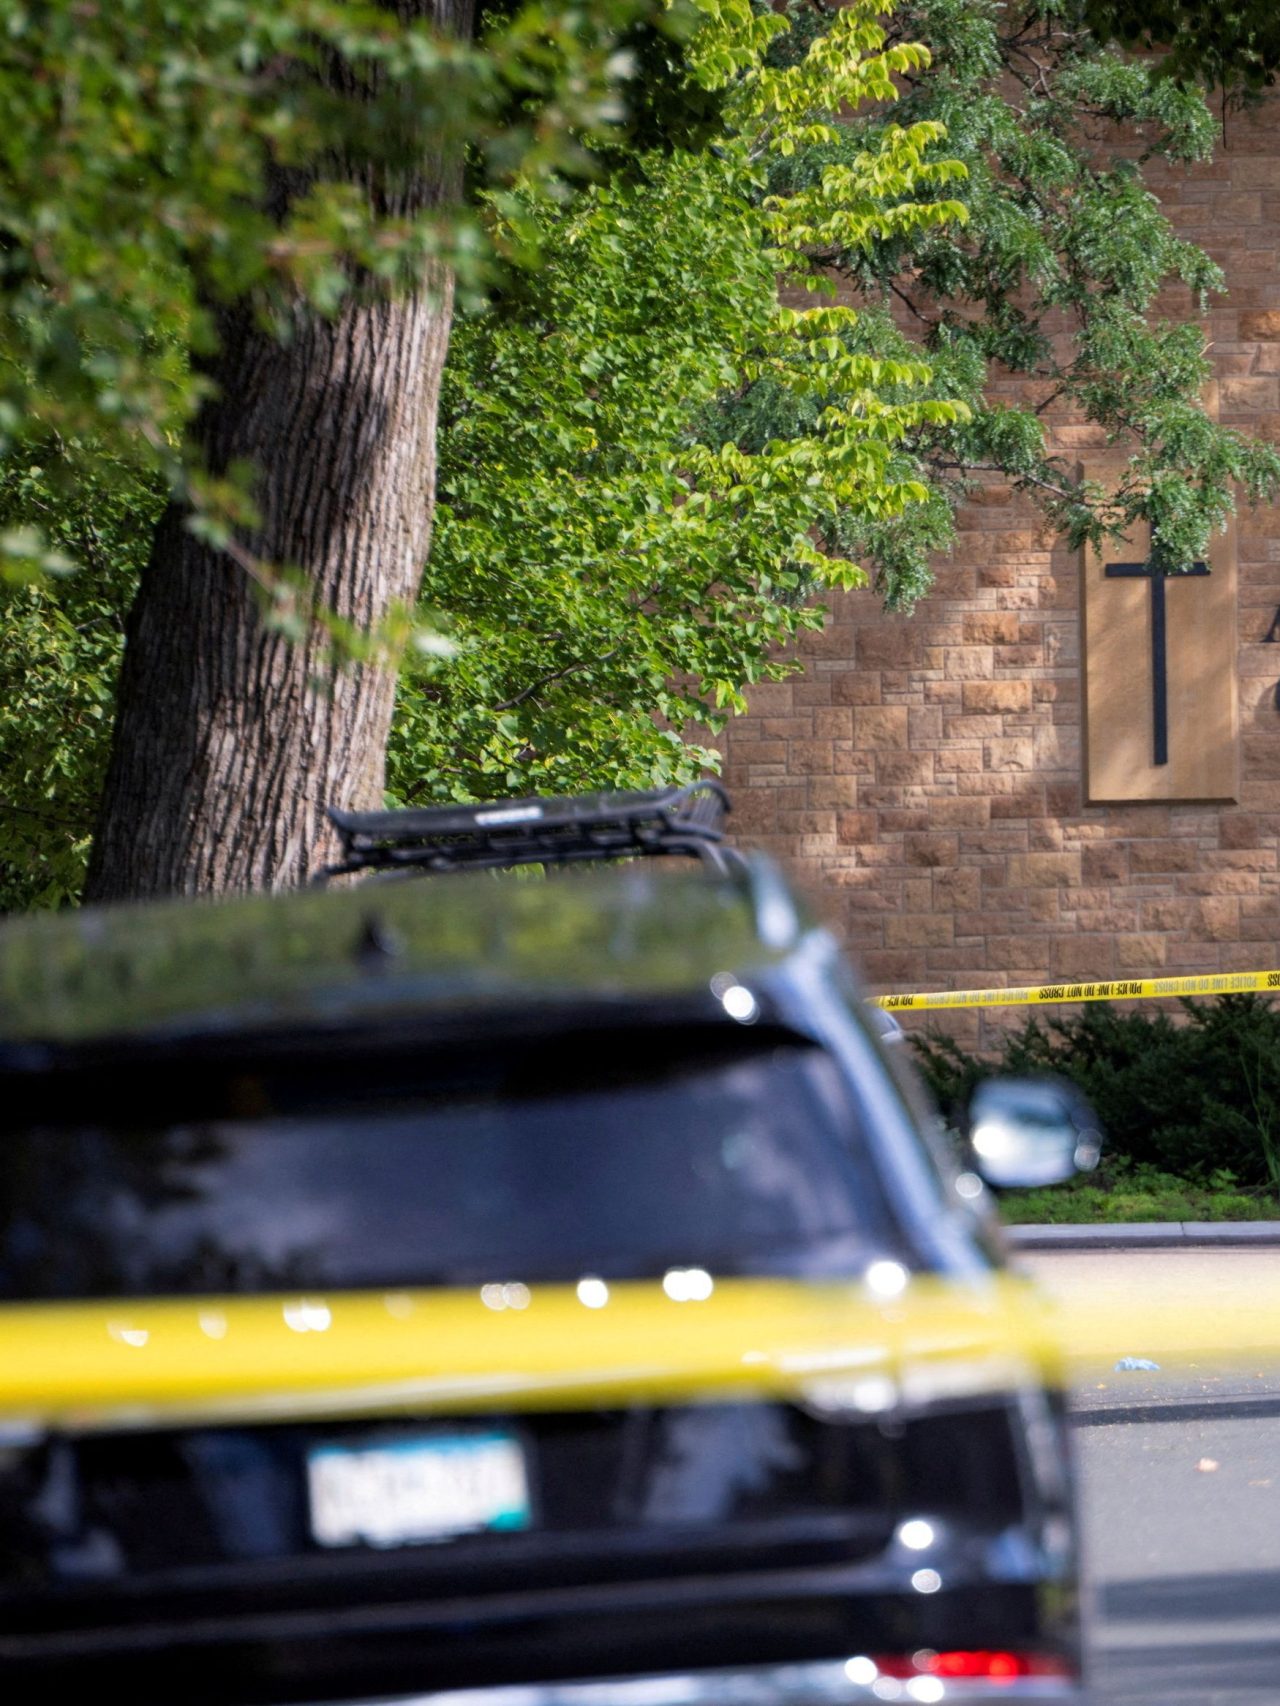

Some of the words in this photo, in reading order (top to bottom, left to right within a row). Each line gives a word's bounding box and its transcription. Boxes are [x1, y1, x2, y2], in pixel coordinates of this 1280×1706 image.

[1039, 986, 1064, 999] CROSS
[1067, 985, 1082, 998] NOT
[1084, 985, 1095, 997] DO
[1099, 984, 1114, 996] LINE
[1116, 982, 1142, 995] POLICE
